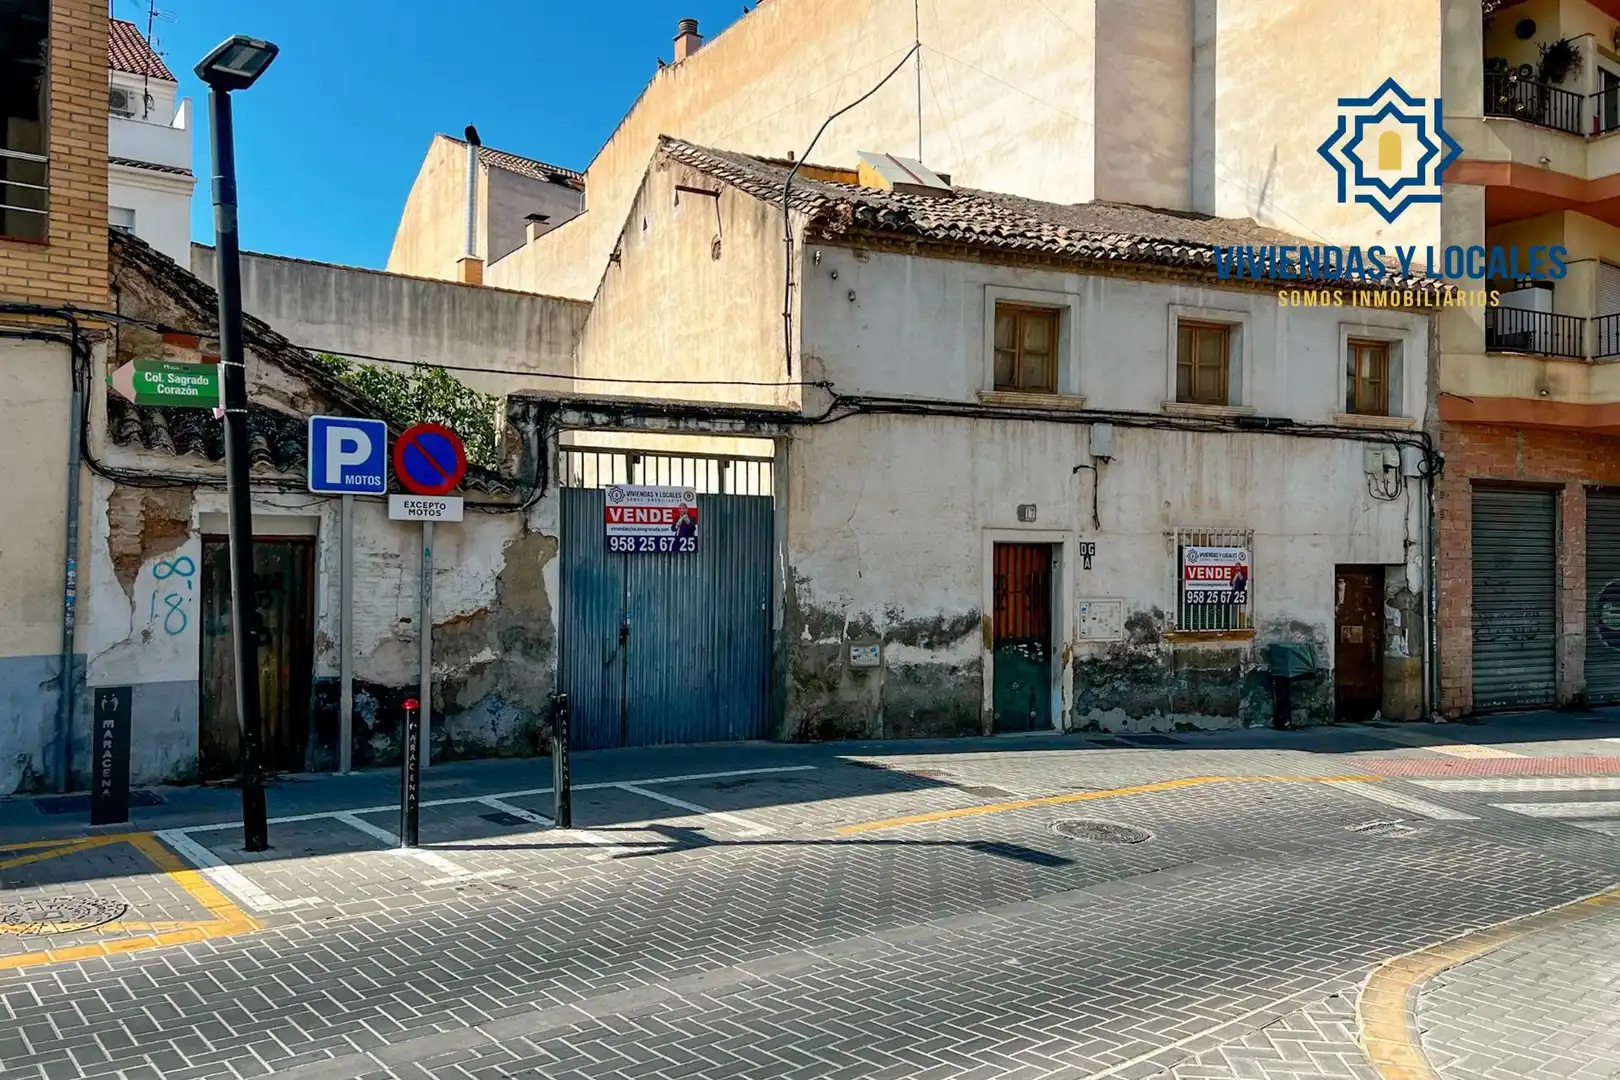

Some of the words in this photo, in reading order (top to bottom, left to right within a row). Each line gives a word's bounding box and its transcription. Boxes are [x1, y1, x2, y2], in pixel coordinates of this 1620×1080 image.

[144, 371, 165, 383] Col.
[167, 372, 210, 387] Sagrado
[156, 383, 199, 397] Corazón
[326, 425, 372, 484] P
[345, 475, 382, 486] MOTOS
[625, 490, 654, 498] VIVIENDAS
[660, 491, 682, 499] LOCALES
[403, 500, 447, 510] EXCEPTO
[408, 508, 442, 517] MOTOS
[609, 508, 673, 522] VENDE
[610, 536, 636, 552] 958
[638, 536, 656, 552] 25
[659, 537, 676, 552] 67
[679, 537, 696, 552] 25
[1187, 567, 1231, 579] VENDE
[1187, 591, 1205, 604] 958
[1206, 591, 1219, 604] 25
[1220, 591, 1232, 604] 67
[1233, 591, 1246, 604] 25
[102, 719, 114, 798] MARACENA
